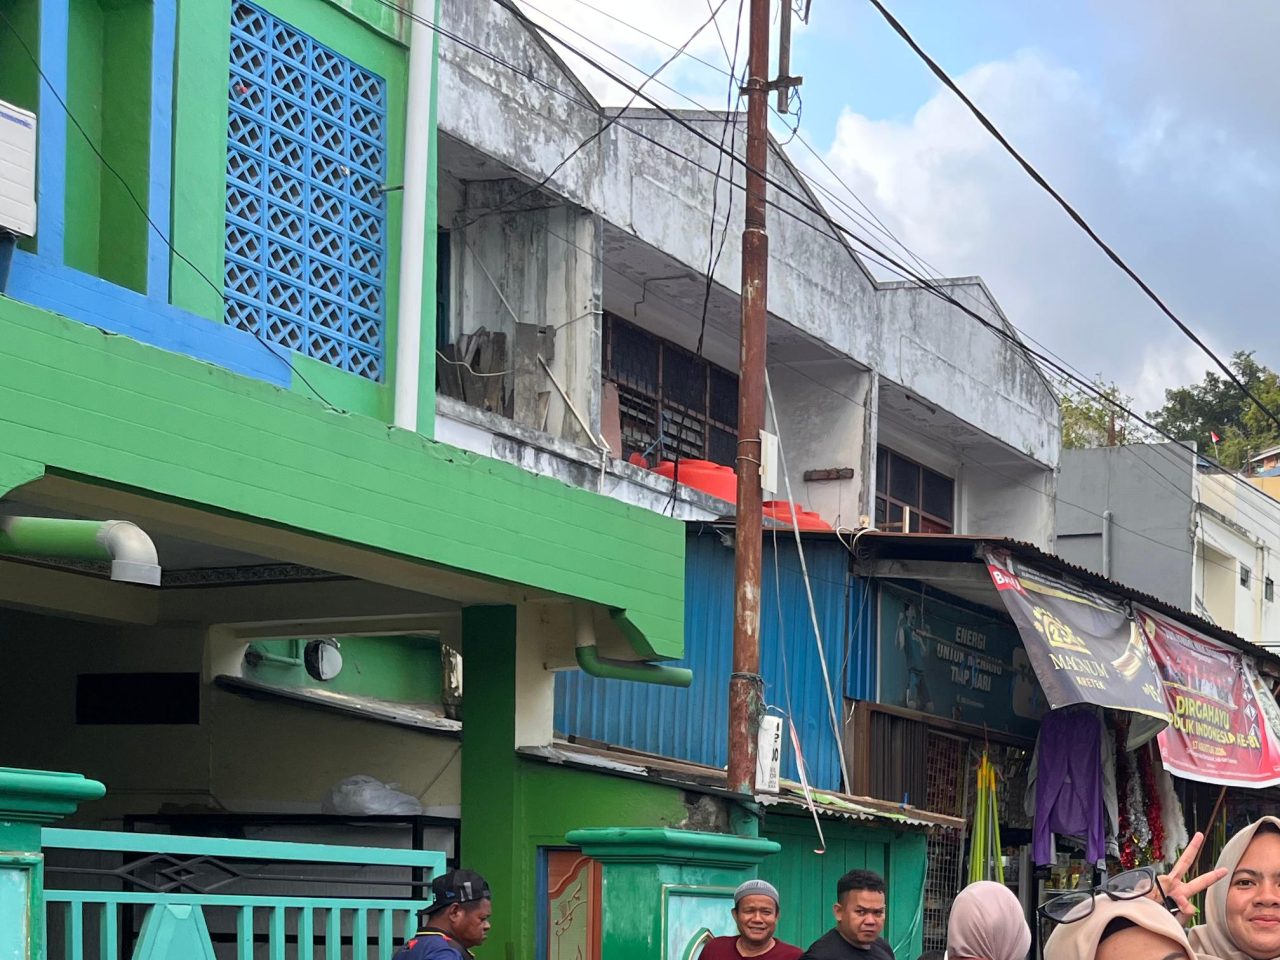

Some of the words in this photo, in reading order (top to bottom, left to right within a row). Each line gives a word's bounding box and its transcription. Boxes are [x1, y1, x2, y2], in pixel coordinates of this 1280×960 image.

[956, 626, 987, 649] ENERGI
[1049, 653, 1109, 679] MAGNUM
[1176, 696, 1230, 730] DIRGAHAYU
